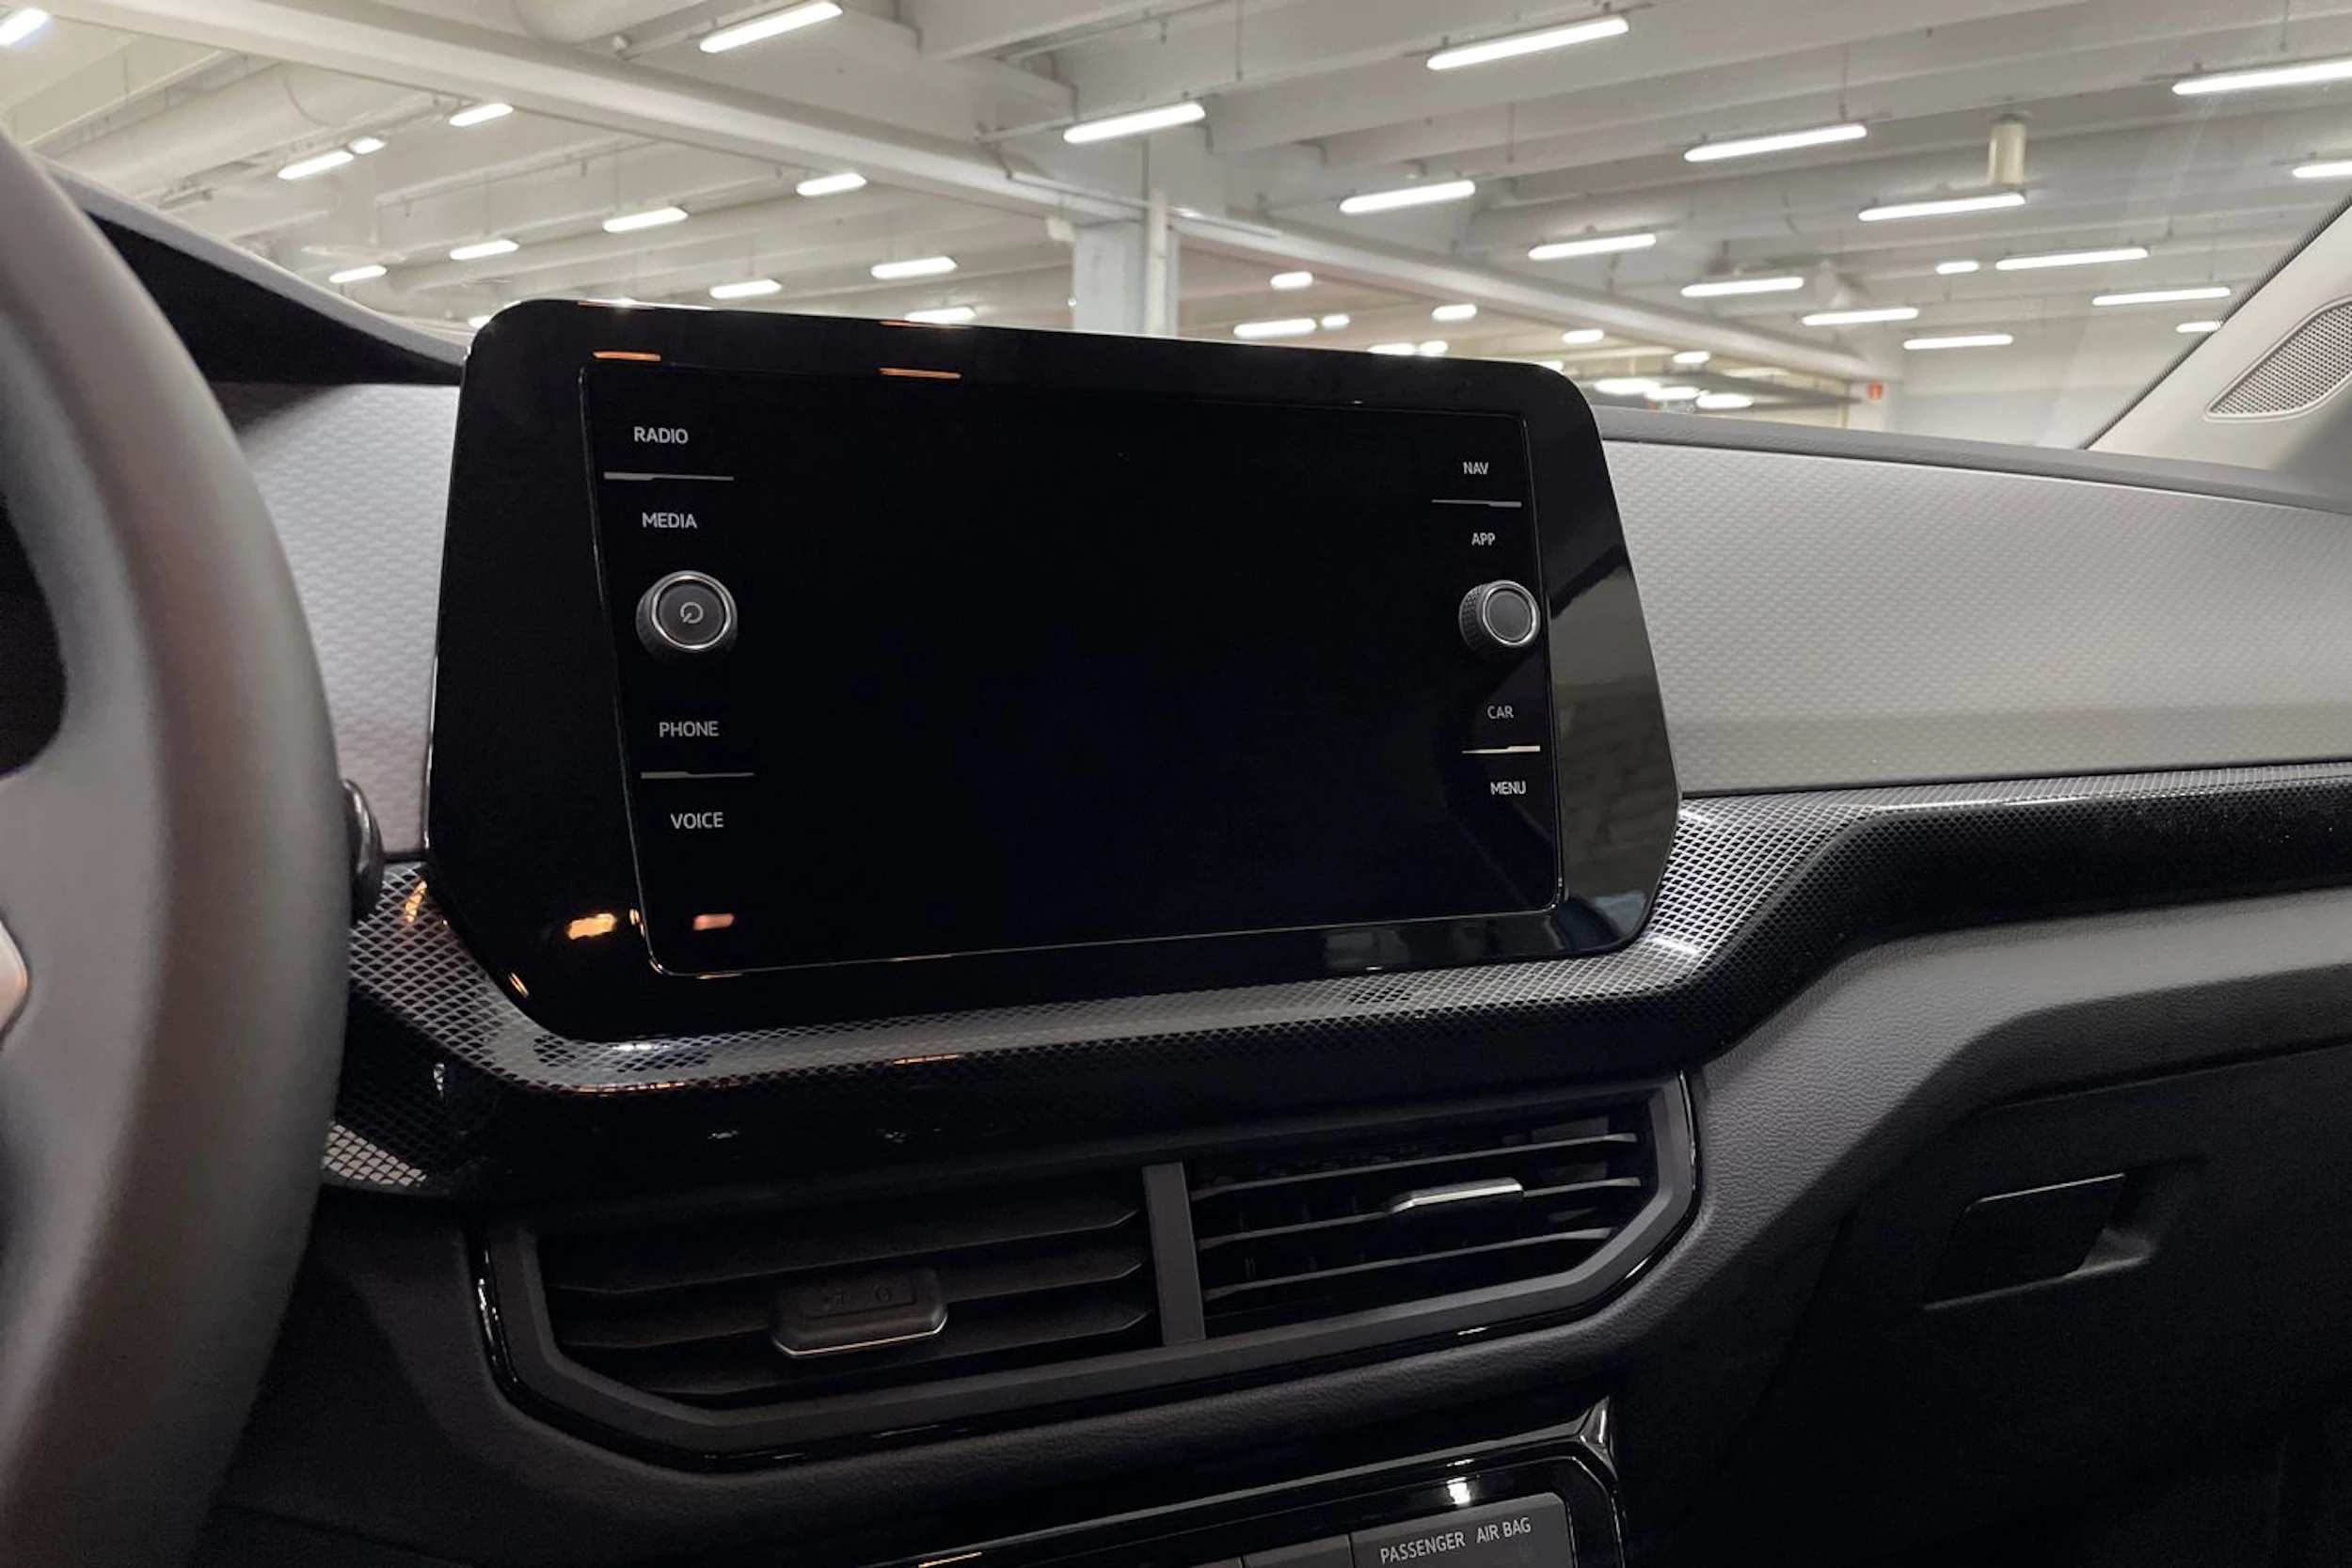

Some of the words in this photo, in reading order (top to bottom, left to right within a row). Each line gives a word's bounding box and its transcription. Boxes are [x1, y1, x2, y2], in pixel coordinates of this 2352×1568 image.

[634, 426, 689, 445] RADIO
[1462, 461, 1489, 475] NAV
[642, 511, 698, 530] MEDIA
[1470, 531, 1496, 546] APP
[1486, 705, 1515, 720] CAR
[659, 720, 720, 738] PHONE
[1489, 780, 1527, 796] MENU
[669, 811, 724, 830] VOICE
[1380, 1531, 1467, 1563] PASSENGER
[1476, 1524, 1501, 1544] AIR
[1503, 1517, 1532, 1538] BAG
